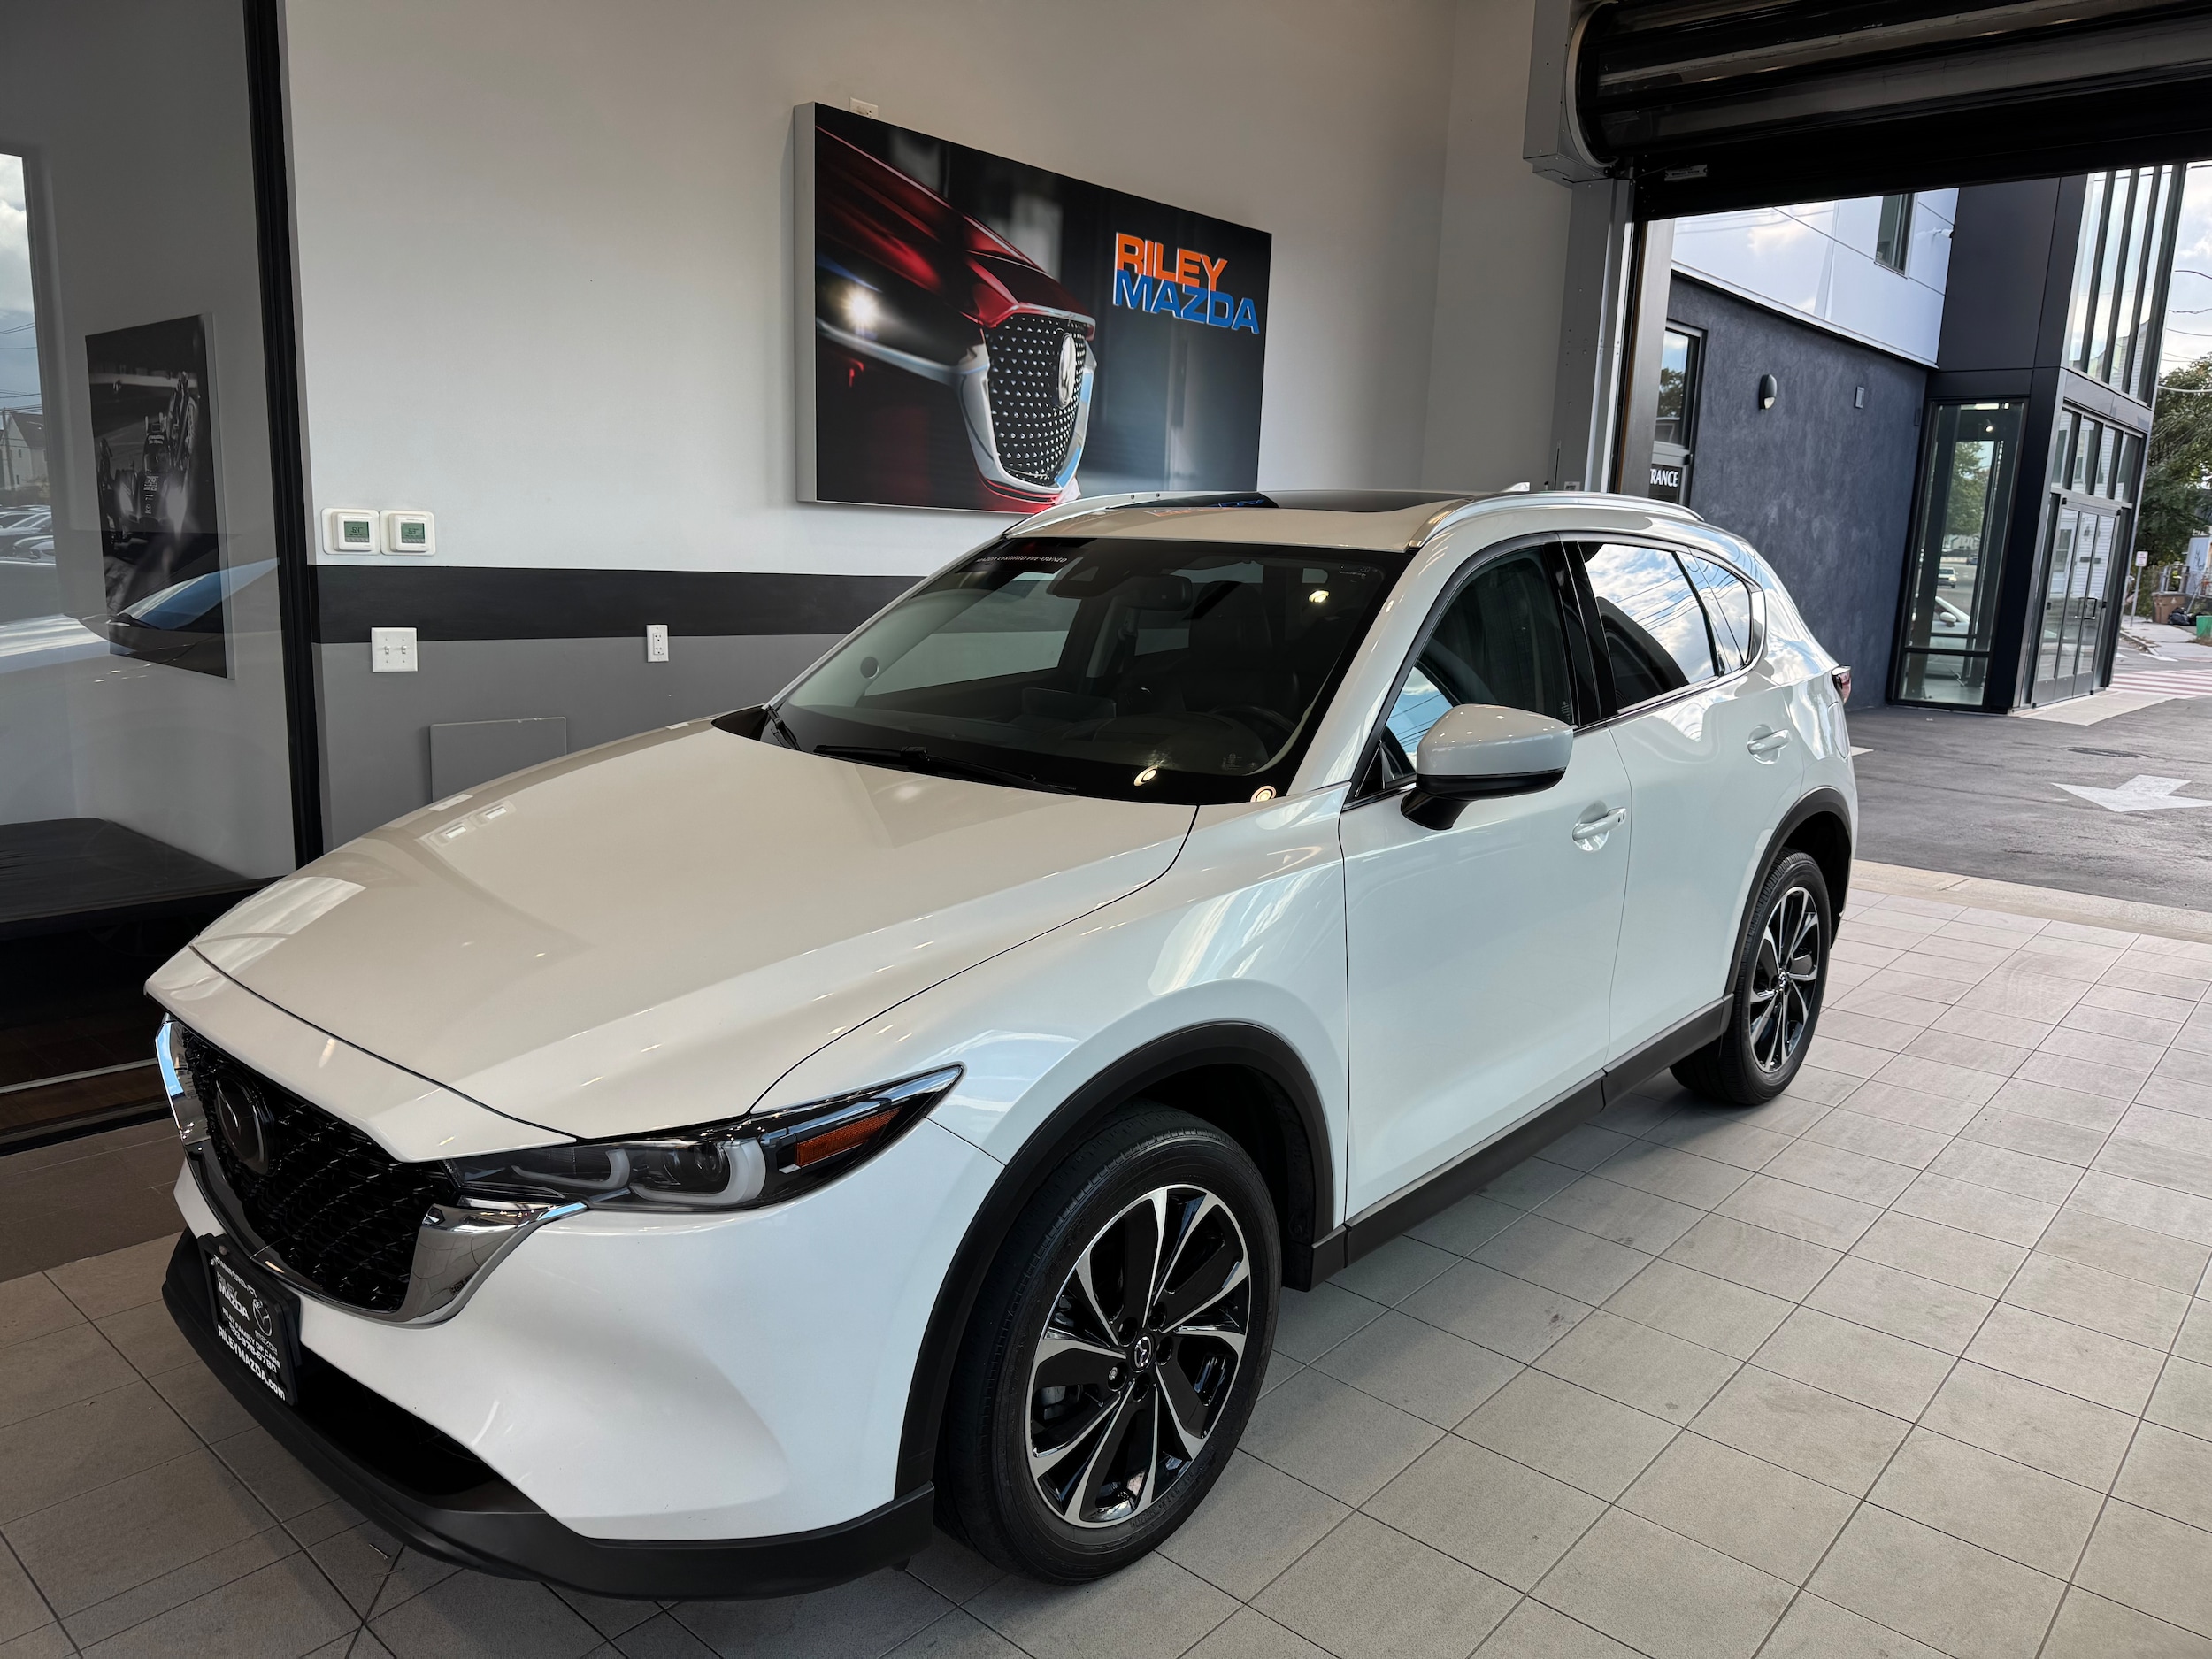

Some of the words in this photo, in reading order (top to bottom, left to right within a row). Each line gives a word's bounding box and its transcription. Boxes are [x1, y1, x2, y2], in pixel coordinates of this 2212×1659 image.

[1115, 232, 1228, 291] RILEY
[1113, 269, 1260, 334] MAZDA
[219, 1283, 250, 1321] MAZDA
[218, 1324, 286, 1402] RILEYMAZDA.com
[234, 1322, 255, 1345] FAMILY
[255, 1341, 265, 1352] OF
[265, 1348, 281, 1369] CARS
